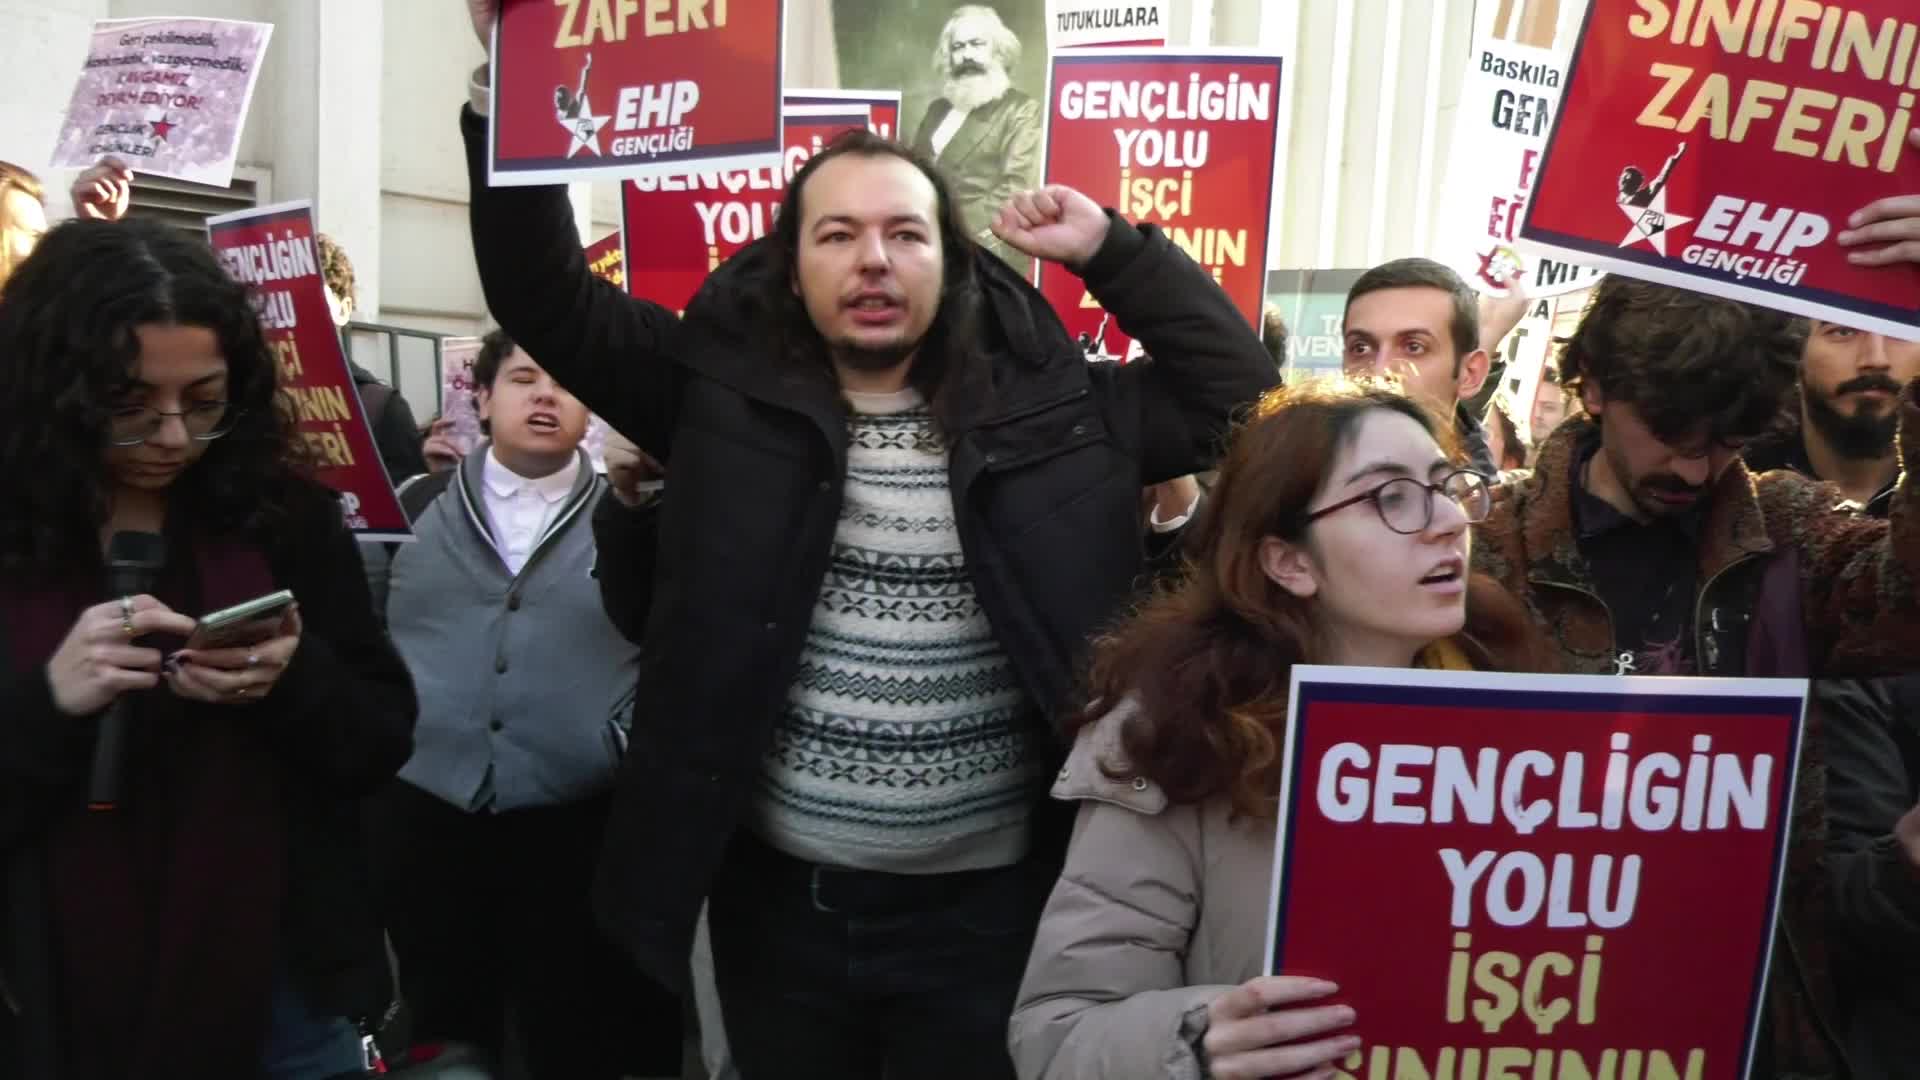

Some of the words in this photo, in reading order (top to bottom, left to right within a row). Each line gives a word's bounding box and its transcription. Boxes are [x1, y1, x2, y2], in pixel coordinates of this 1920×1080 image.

[1057, 6, 1159, 32] TUTUKLULARA
[615, 80, 699, 132] EHP
[1059, 72, 1271, 122] GENÇLİGİN
[1635, 62, 1915, 173] ZAFERİ
[611, 126, 694, 158] GENÇLİĞİ
[1113, 128, 1209, 168] YOLU
[1119, 168, 1193, 220] İŞÇİ
[1693, 194, 1830, 257] EHP
[1681, 244, 1808, 287] GENÇLİĞİ
[1316, 732, 1774, 834] GENÇLİGİN
[1438, 848, 1642, 928] YOLU
[1445, 932, 1604, 1034] İŞÇİ
